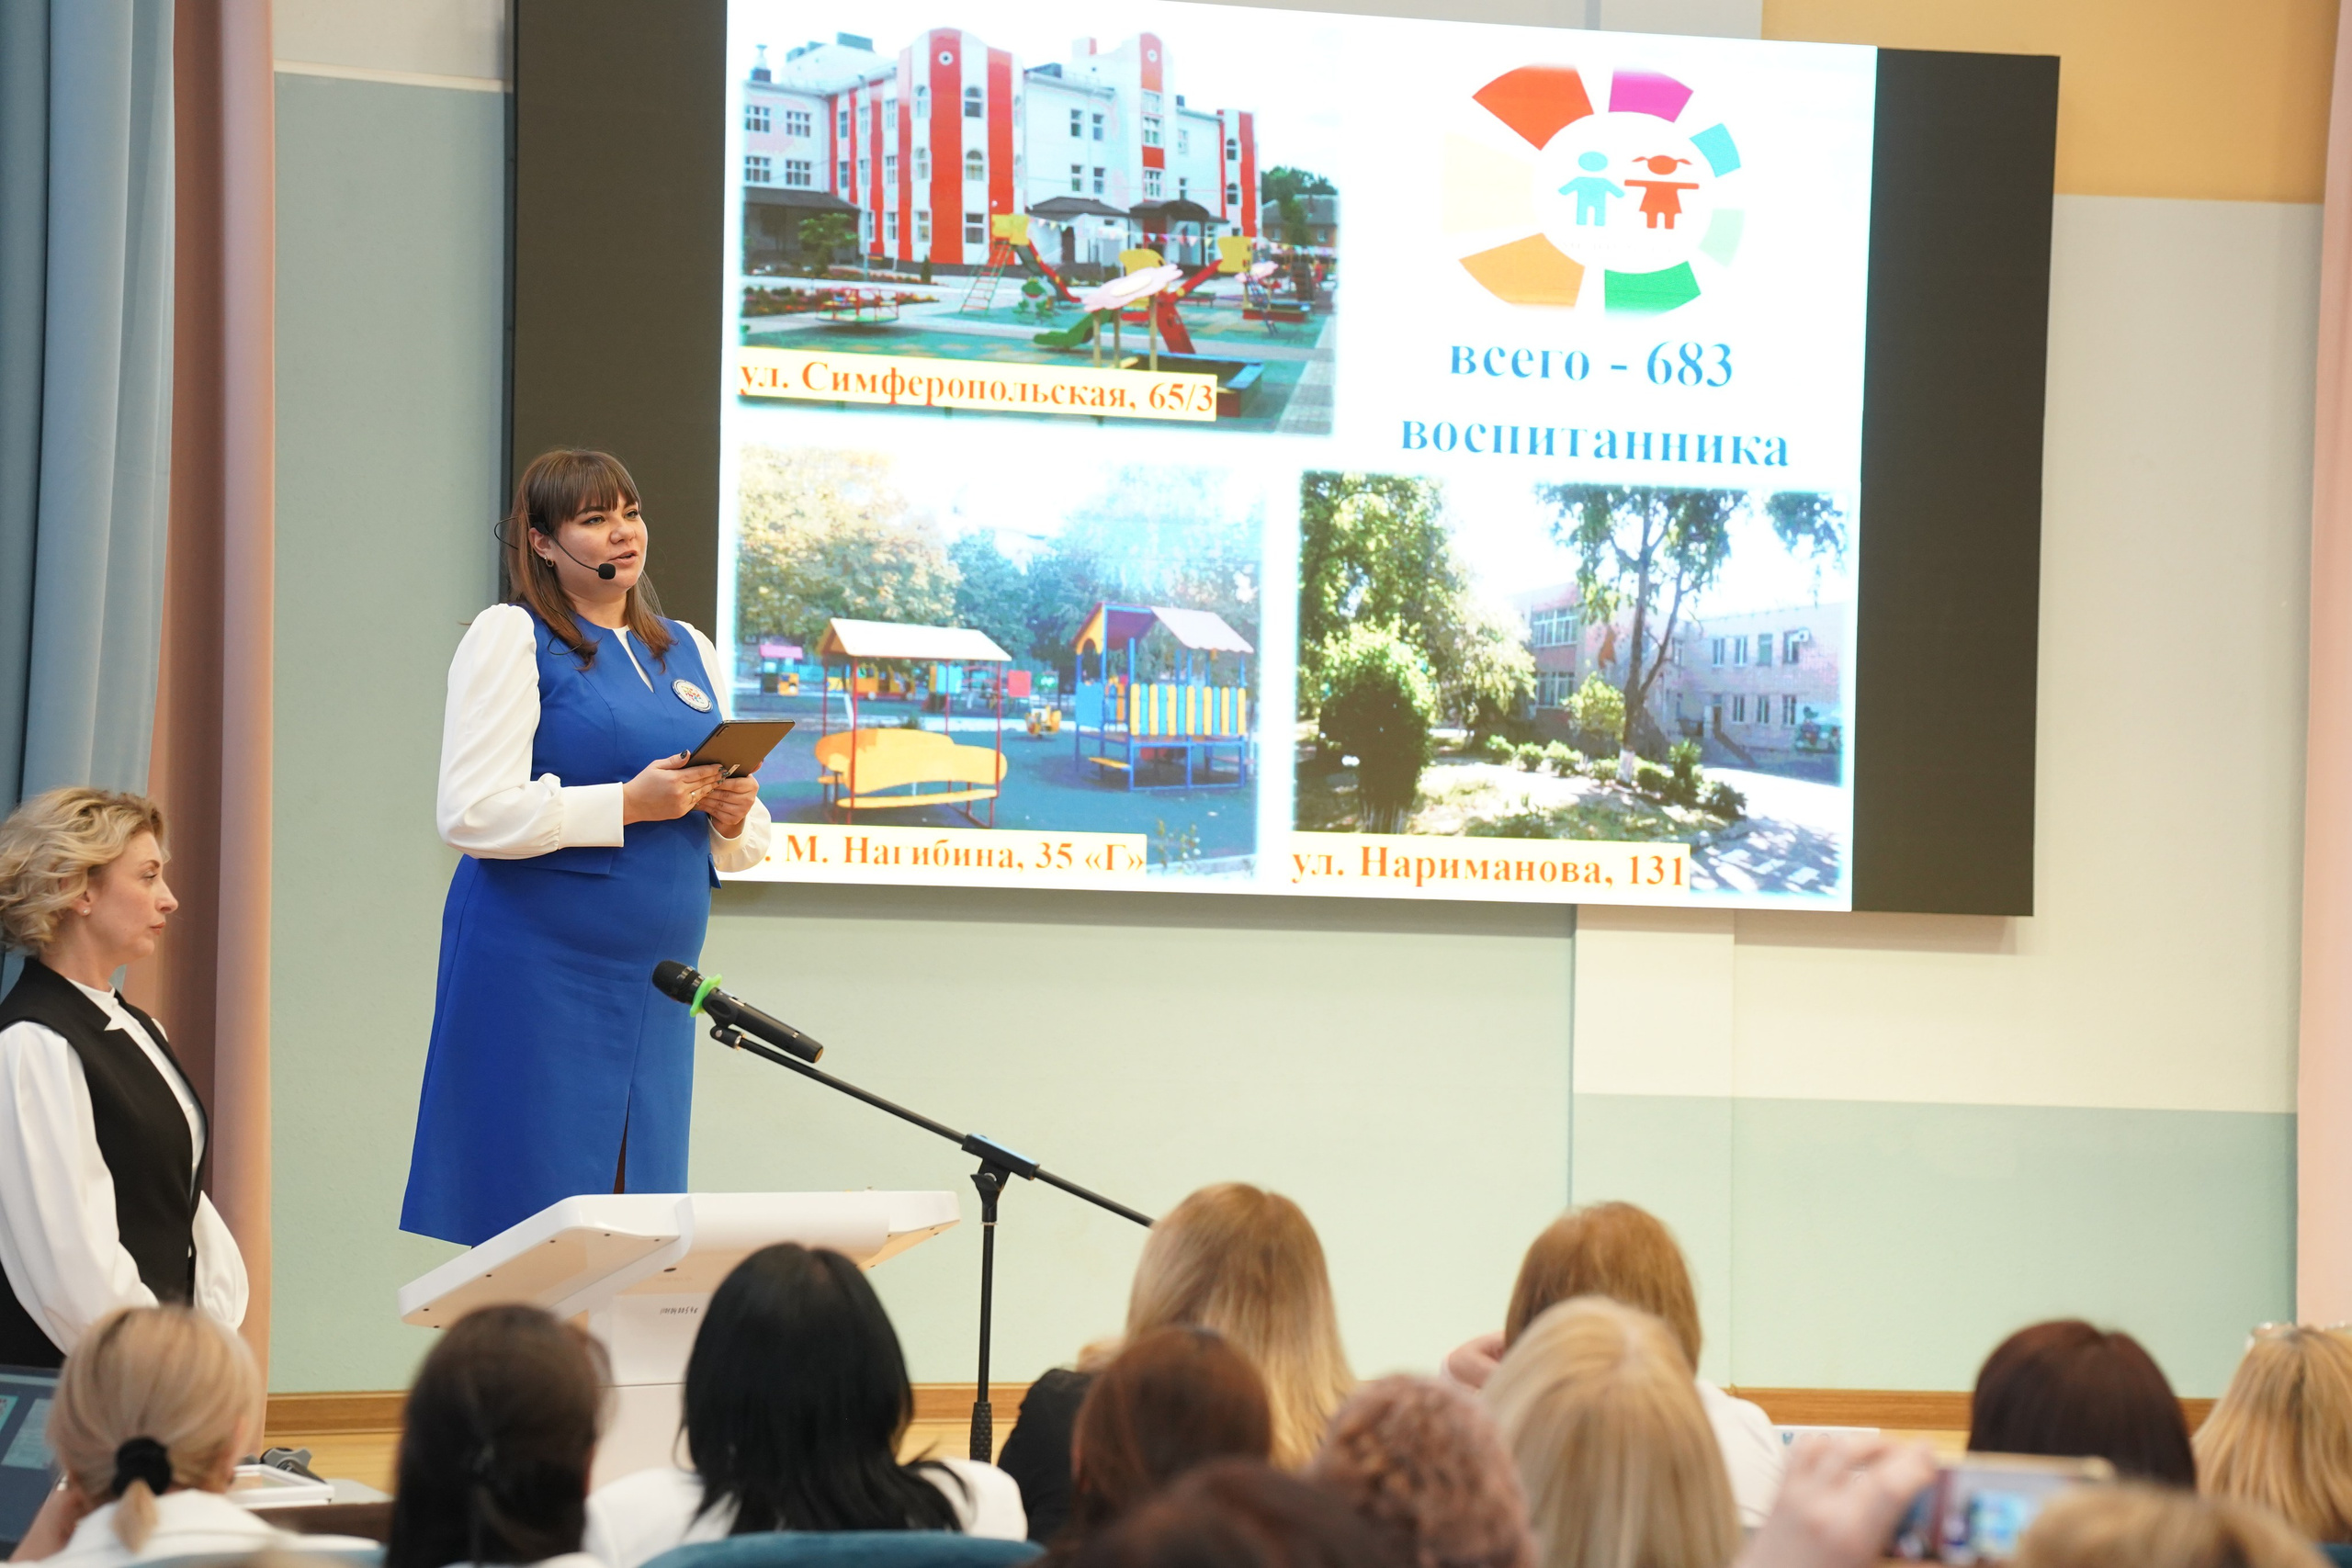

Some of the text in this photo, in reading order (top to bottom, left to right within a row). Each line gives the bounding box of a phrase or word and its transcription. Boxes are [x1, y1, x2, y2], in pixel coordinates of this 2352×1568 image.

[740, 361, 1215, 412] ул. Симферопольская, 65/3
[1450, 344, 1590, 381] всего
[1646, 341, 1734, 388] 683
[1401, 420, 1790, 468] воспитанника
[786, 834, 1145, 872] М. Нагибина, 35 «Г»
[1292, 845, 1683, 888] ул. Нариманова, 131
